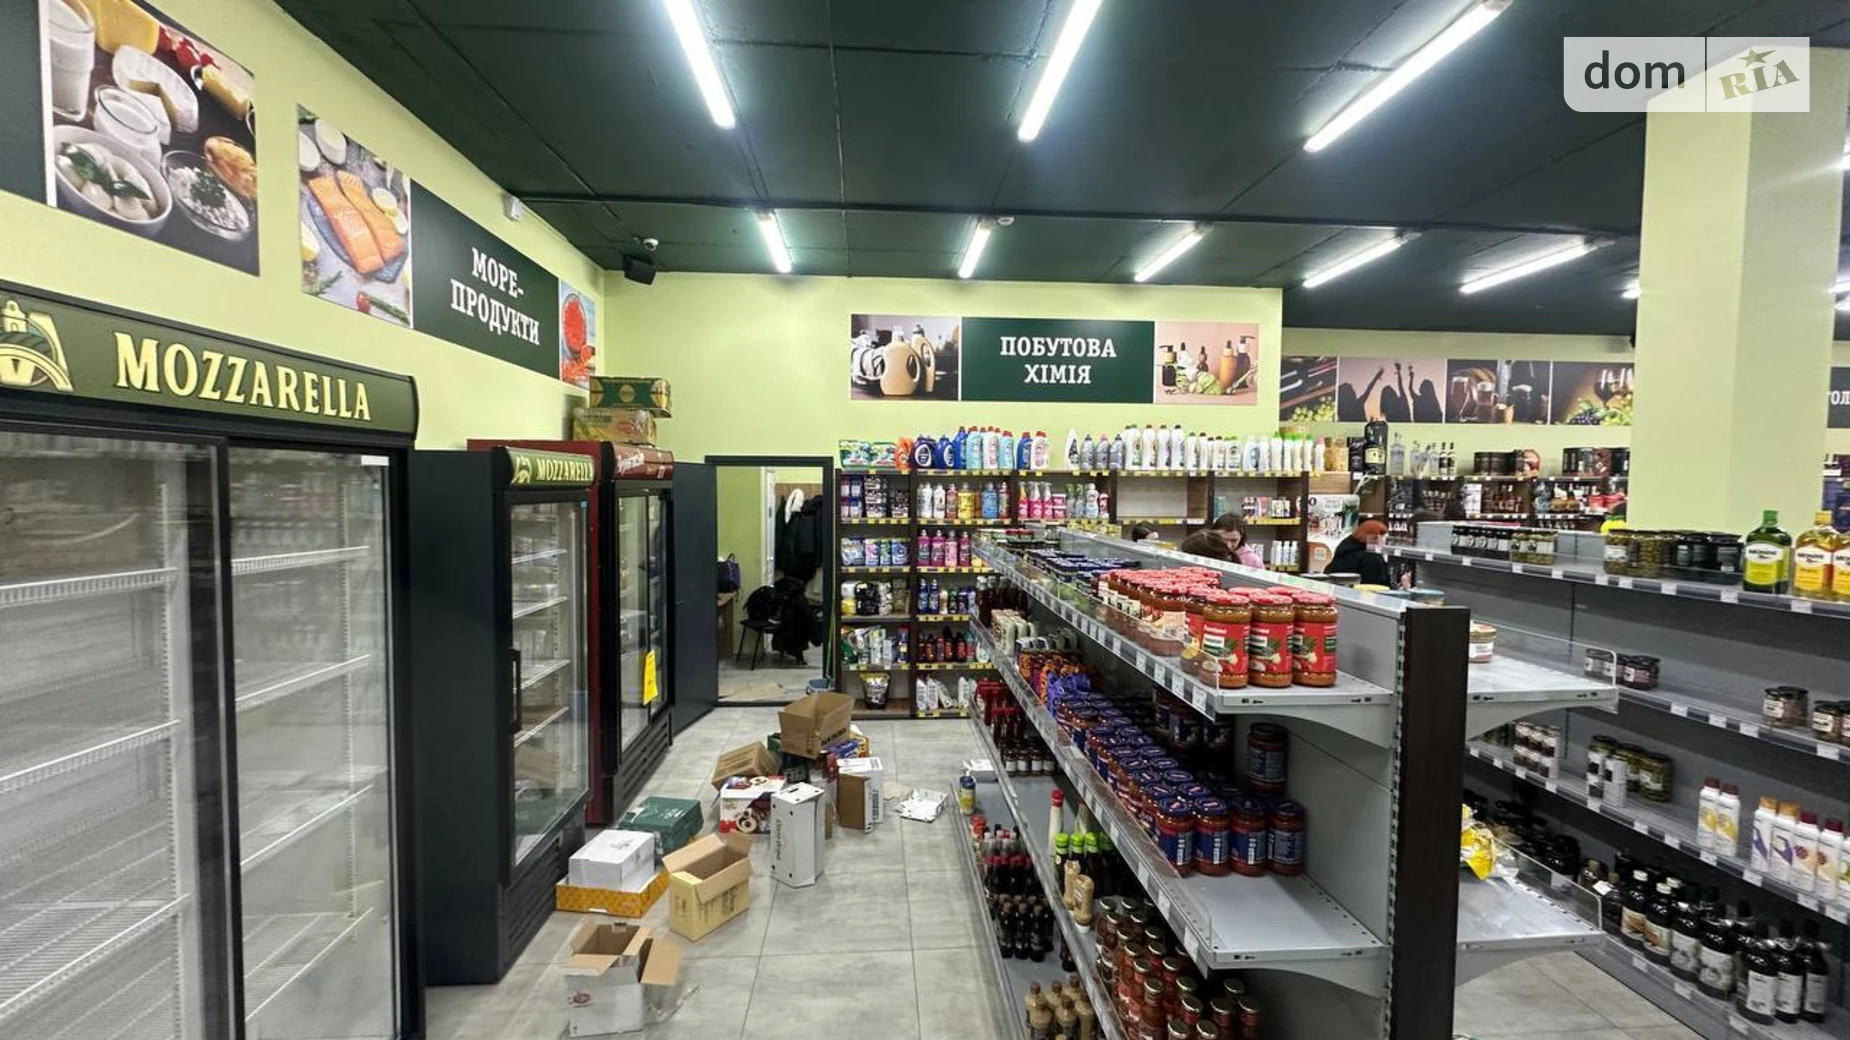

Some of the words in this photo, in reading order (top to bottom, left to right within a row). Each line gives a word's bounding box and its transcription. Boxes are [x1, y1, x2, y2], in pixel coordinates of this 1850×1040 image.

[472, 247, 524, 298] МОРЕ-
[450, 278, 540, 346] ПРОДУКТИ
[1000, 336, 1117, 358] ПОБУТОВА
[114, 332, 371, 420] MOZZARELLA
[1024, 364, 1092, 384] ХІМІЯ
[537, 458, 594, 481] MOZZARELLA
